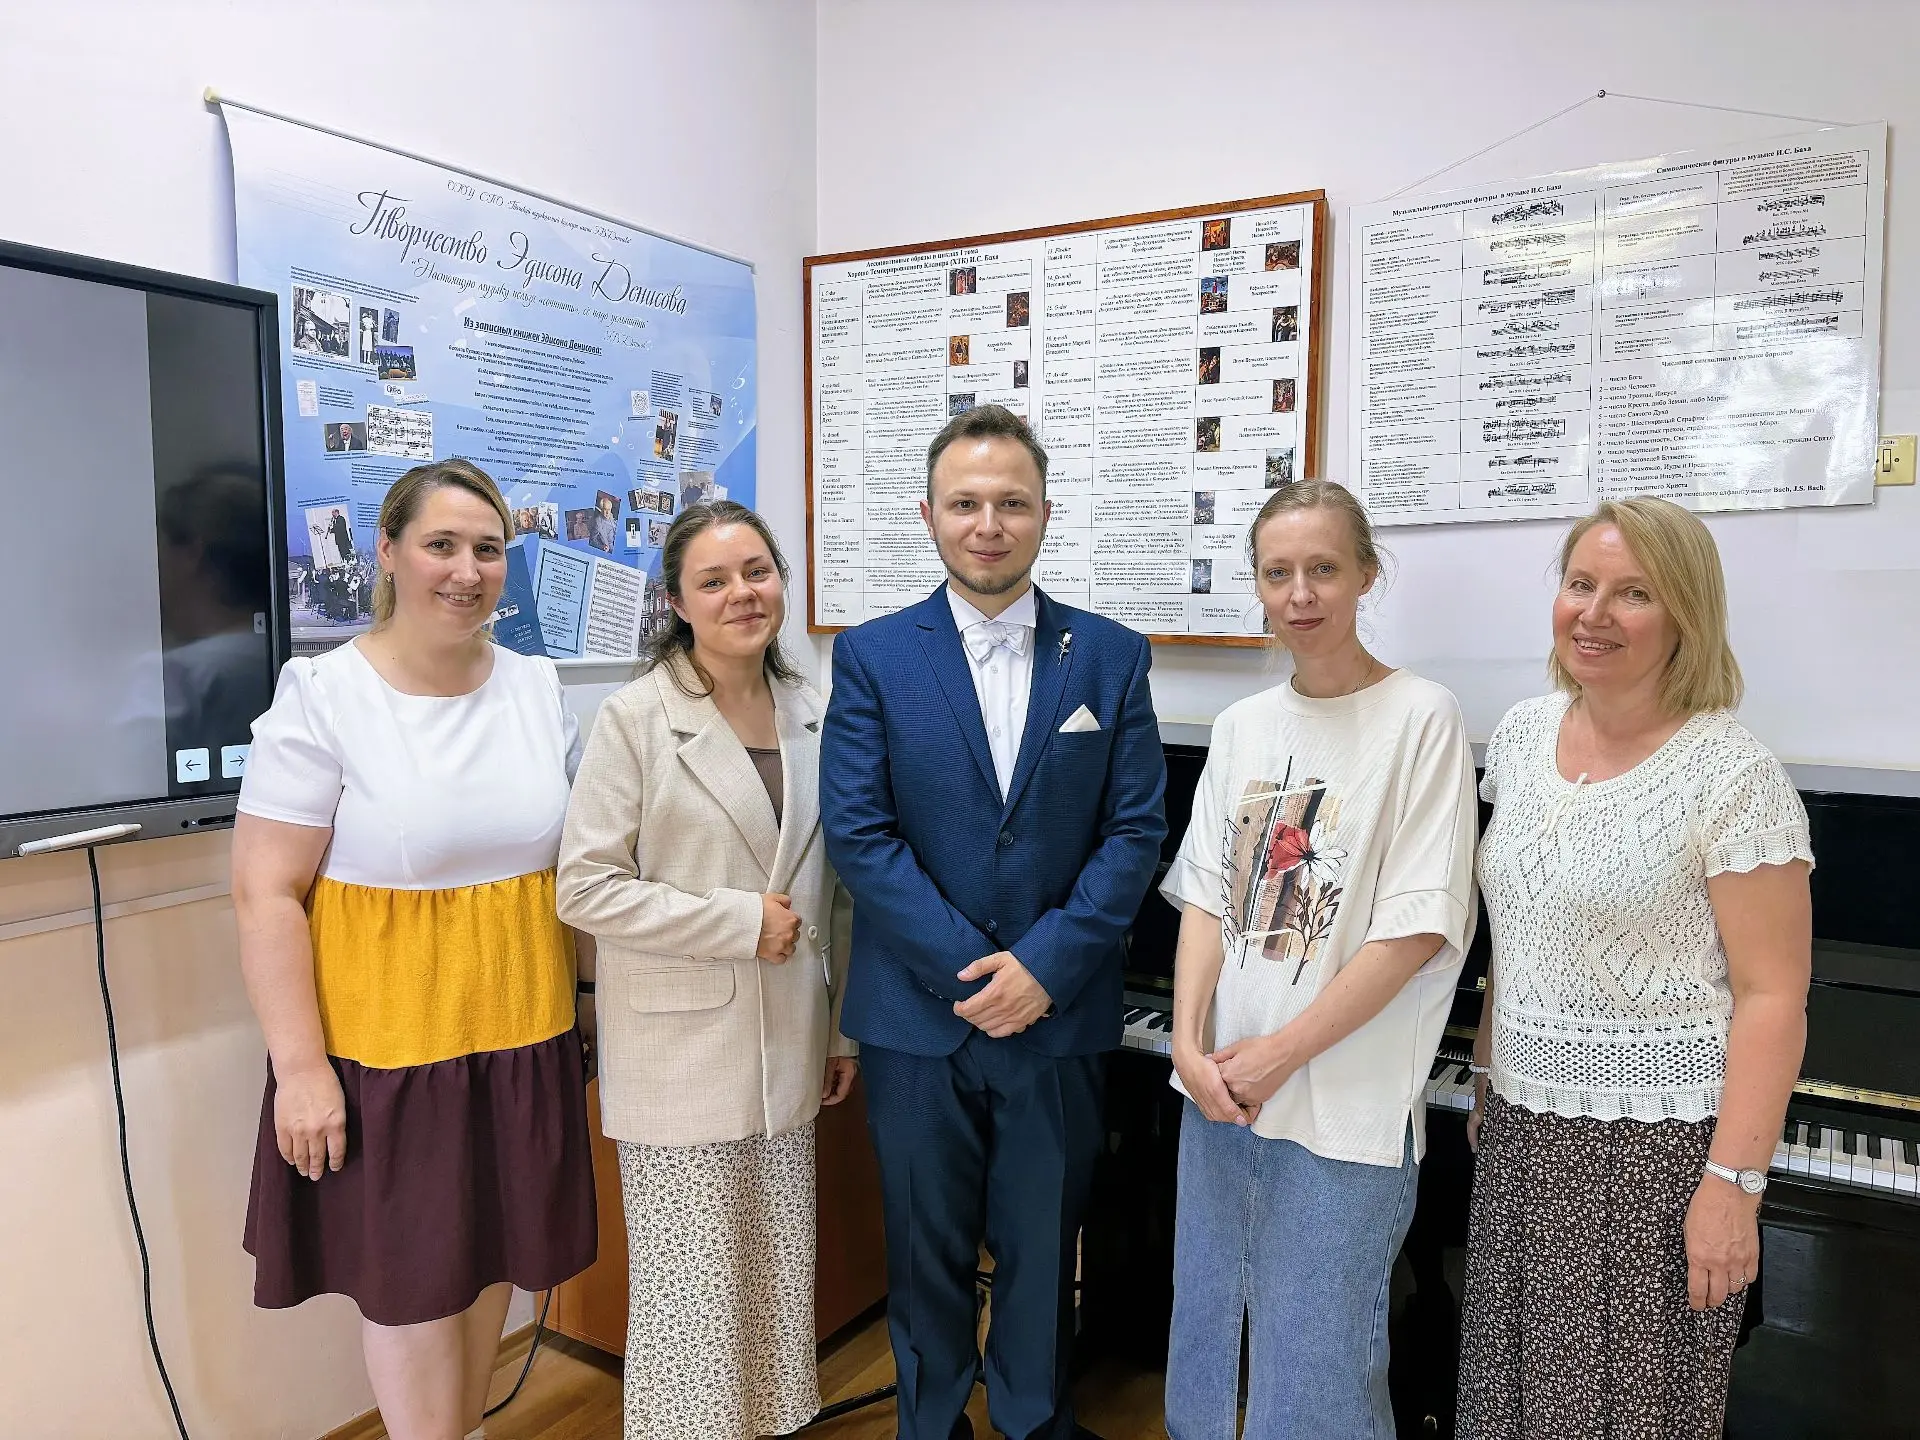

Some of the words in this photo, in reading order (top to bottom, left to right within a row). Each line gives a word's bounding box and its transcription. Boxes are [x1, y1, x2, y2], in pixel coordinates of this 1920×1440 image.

[1776, 148, 1792, 156] И.С.
[1794, 145, 1812, 154] Баха
[350, 190, 488, 263] Творчество
[496, 231, 583, 288] Эдисона
[591, 252, 687, 315] Денисова
[478, 283, 509, 302] музыку
[464, 317, 474, 328] Из
[475, 322, 512, 336] записных
[513, 328, 540, 342] книжек
[541, 333, 568, 347] Эдисона
[568, 339, 602, 355] Денисова:
